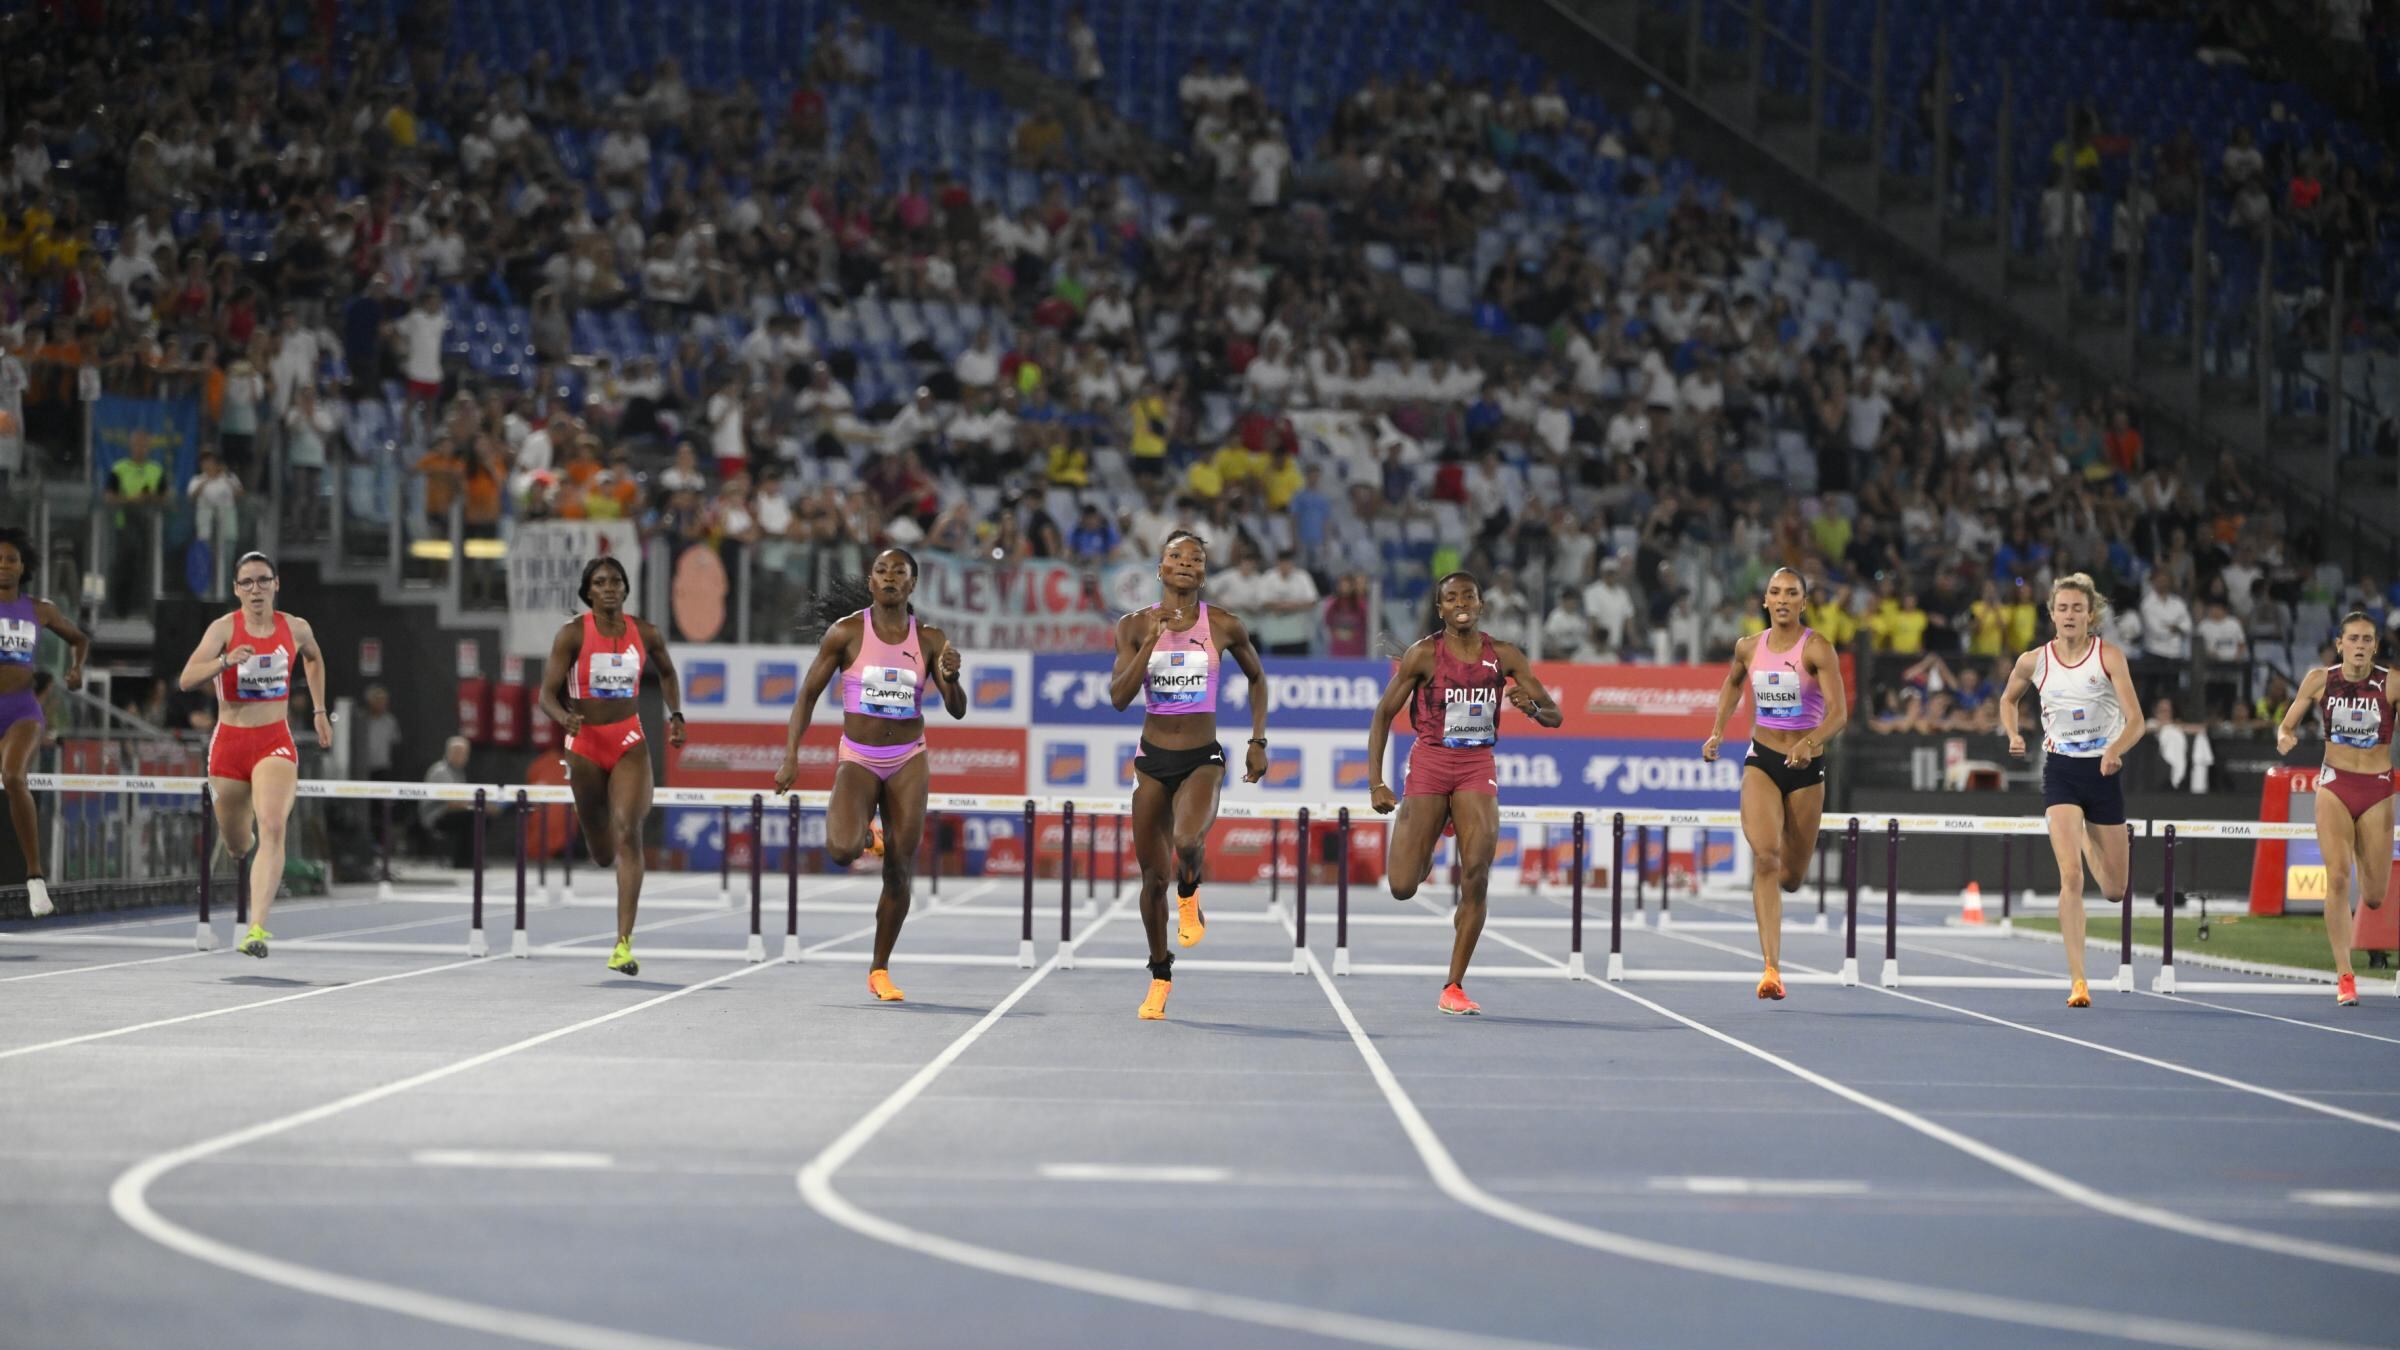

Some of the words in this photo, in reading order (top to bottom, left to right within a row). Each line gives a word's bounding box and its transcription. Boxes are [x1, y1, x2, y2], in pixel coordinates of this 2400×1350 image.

[919, 562, 1105, 617] TLETICA
[1152, 674, 1203, 687] KNIGHT
[865, 687, 913, 701] CLAYTON
[1445, 687, 1497, 704] POLIZIA
[1756, 691, 1797, 702] NIELSEN
[2326, 695, 2380, 712] POLIZIA
[126, 780, 156, 790] ROMA
[1222, 808, 1251, 816] ROMA
[1670, 815, 1700, 825] ROMA
[1944, 820, 1975, 829] ROMA
[2221, 825, 2251, 835] ROMA
